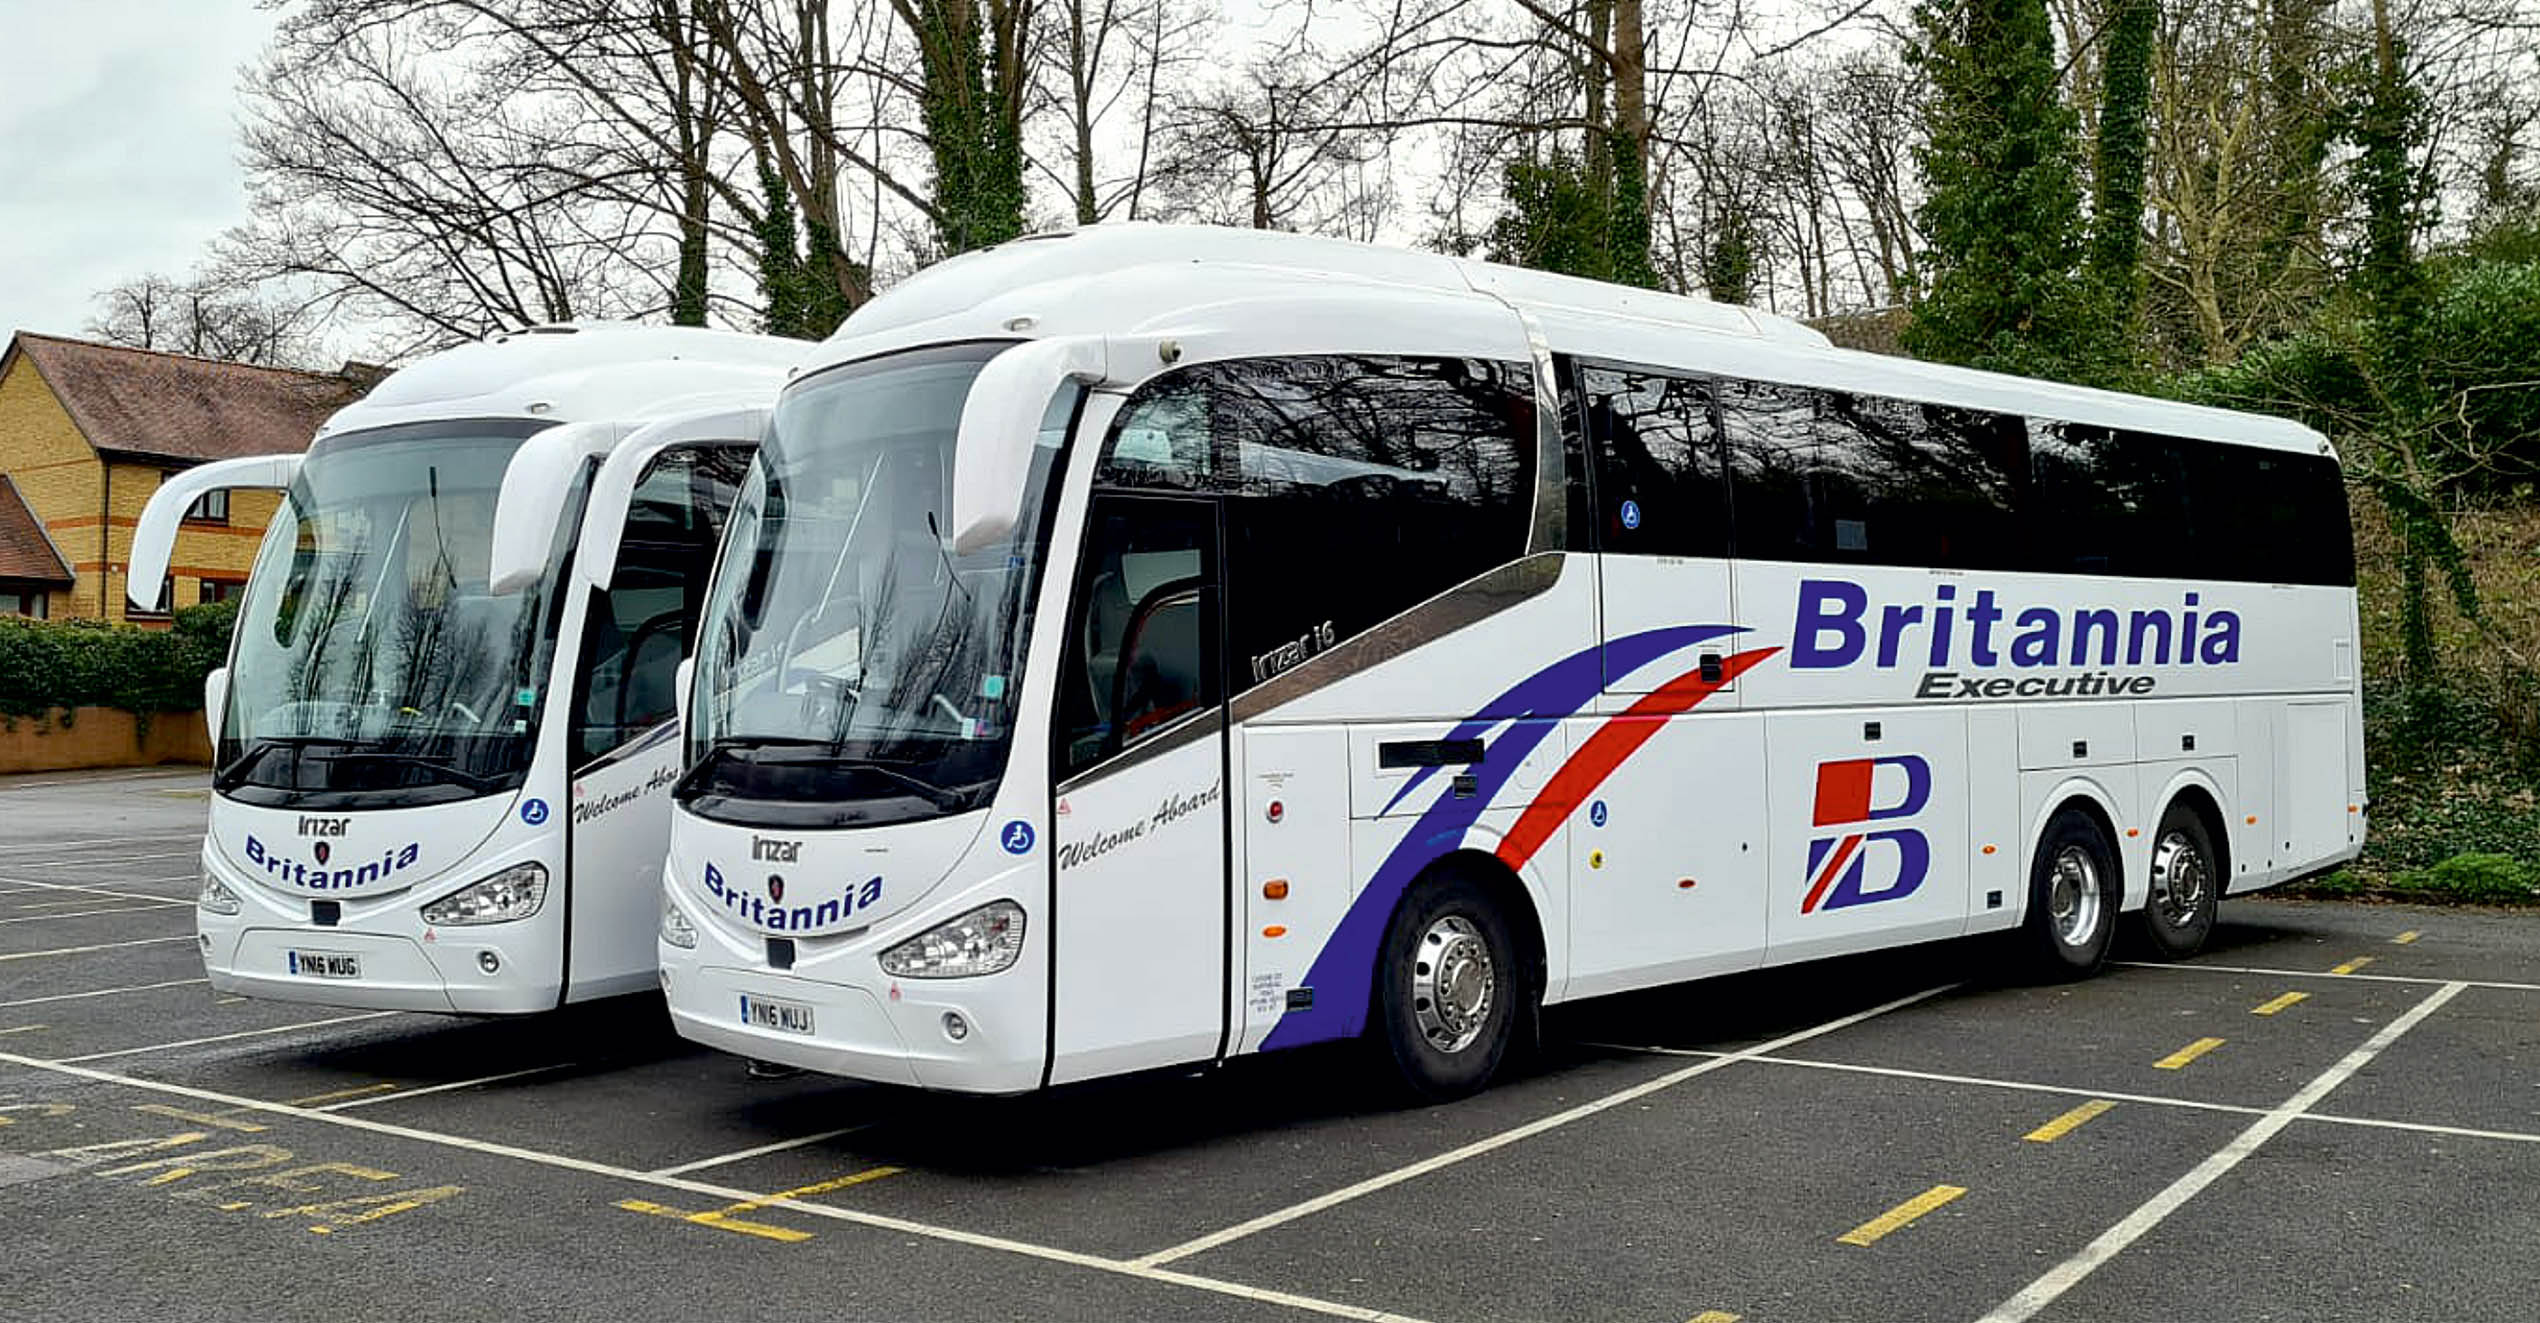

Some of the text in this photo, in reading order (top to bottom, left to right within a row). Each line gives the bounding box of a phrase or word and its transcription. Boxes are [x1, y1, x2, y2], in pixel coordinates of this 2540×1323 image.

[1790, 579, 2241, 669] Britannia
[1915, 671, 2156, 699] Executive
[574, 793, 640, 824] Welcome
[1058, 776, 1221, 870] Welcome Aboard
[246, 834, 419, 890] Britannia
[704, 860, 883, 931] Britannia
